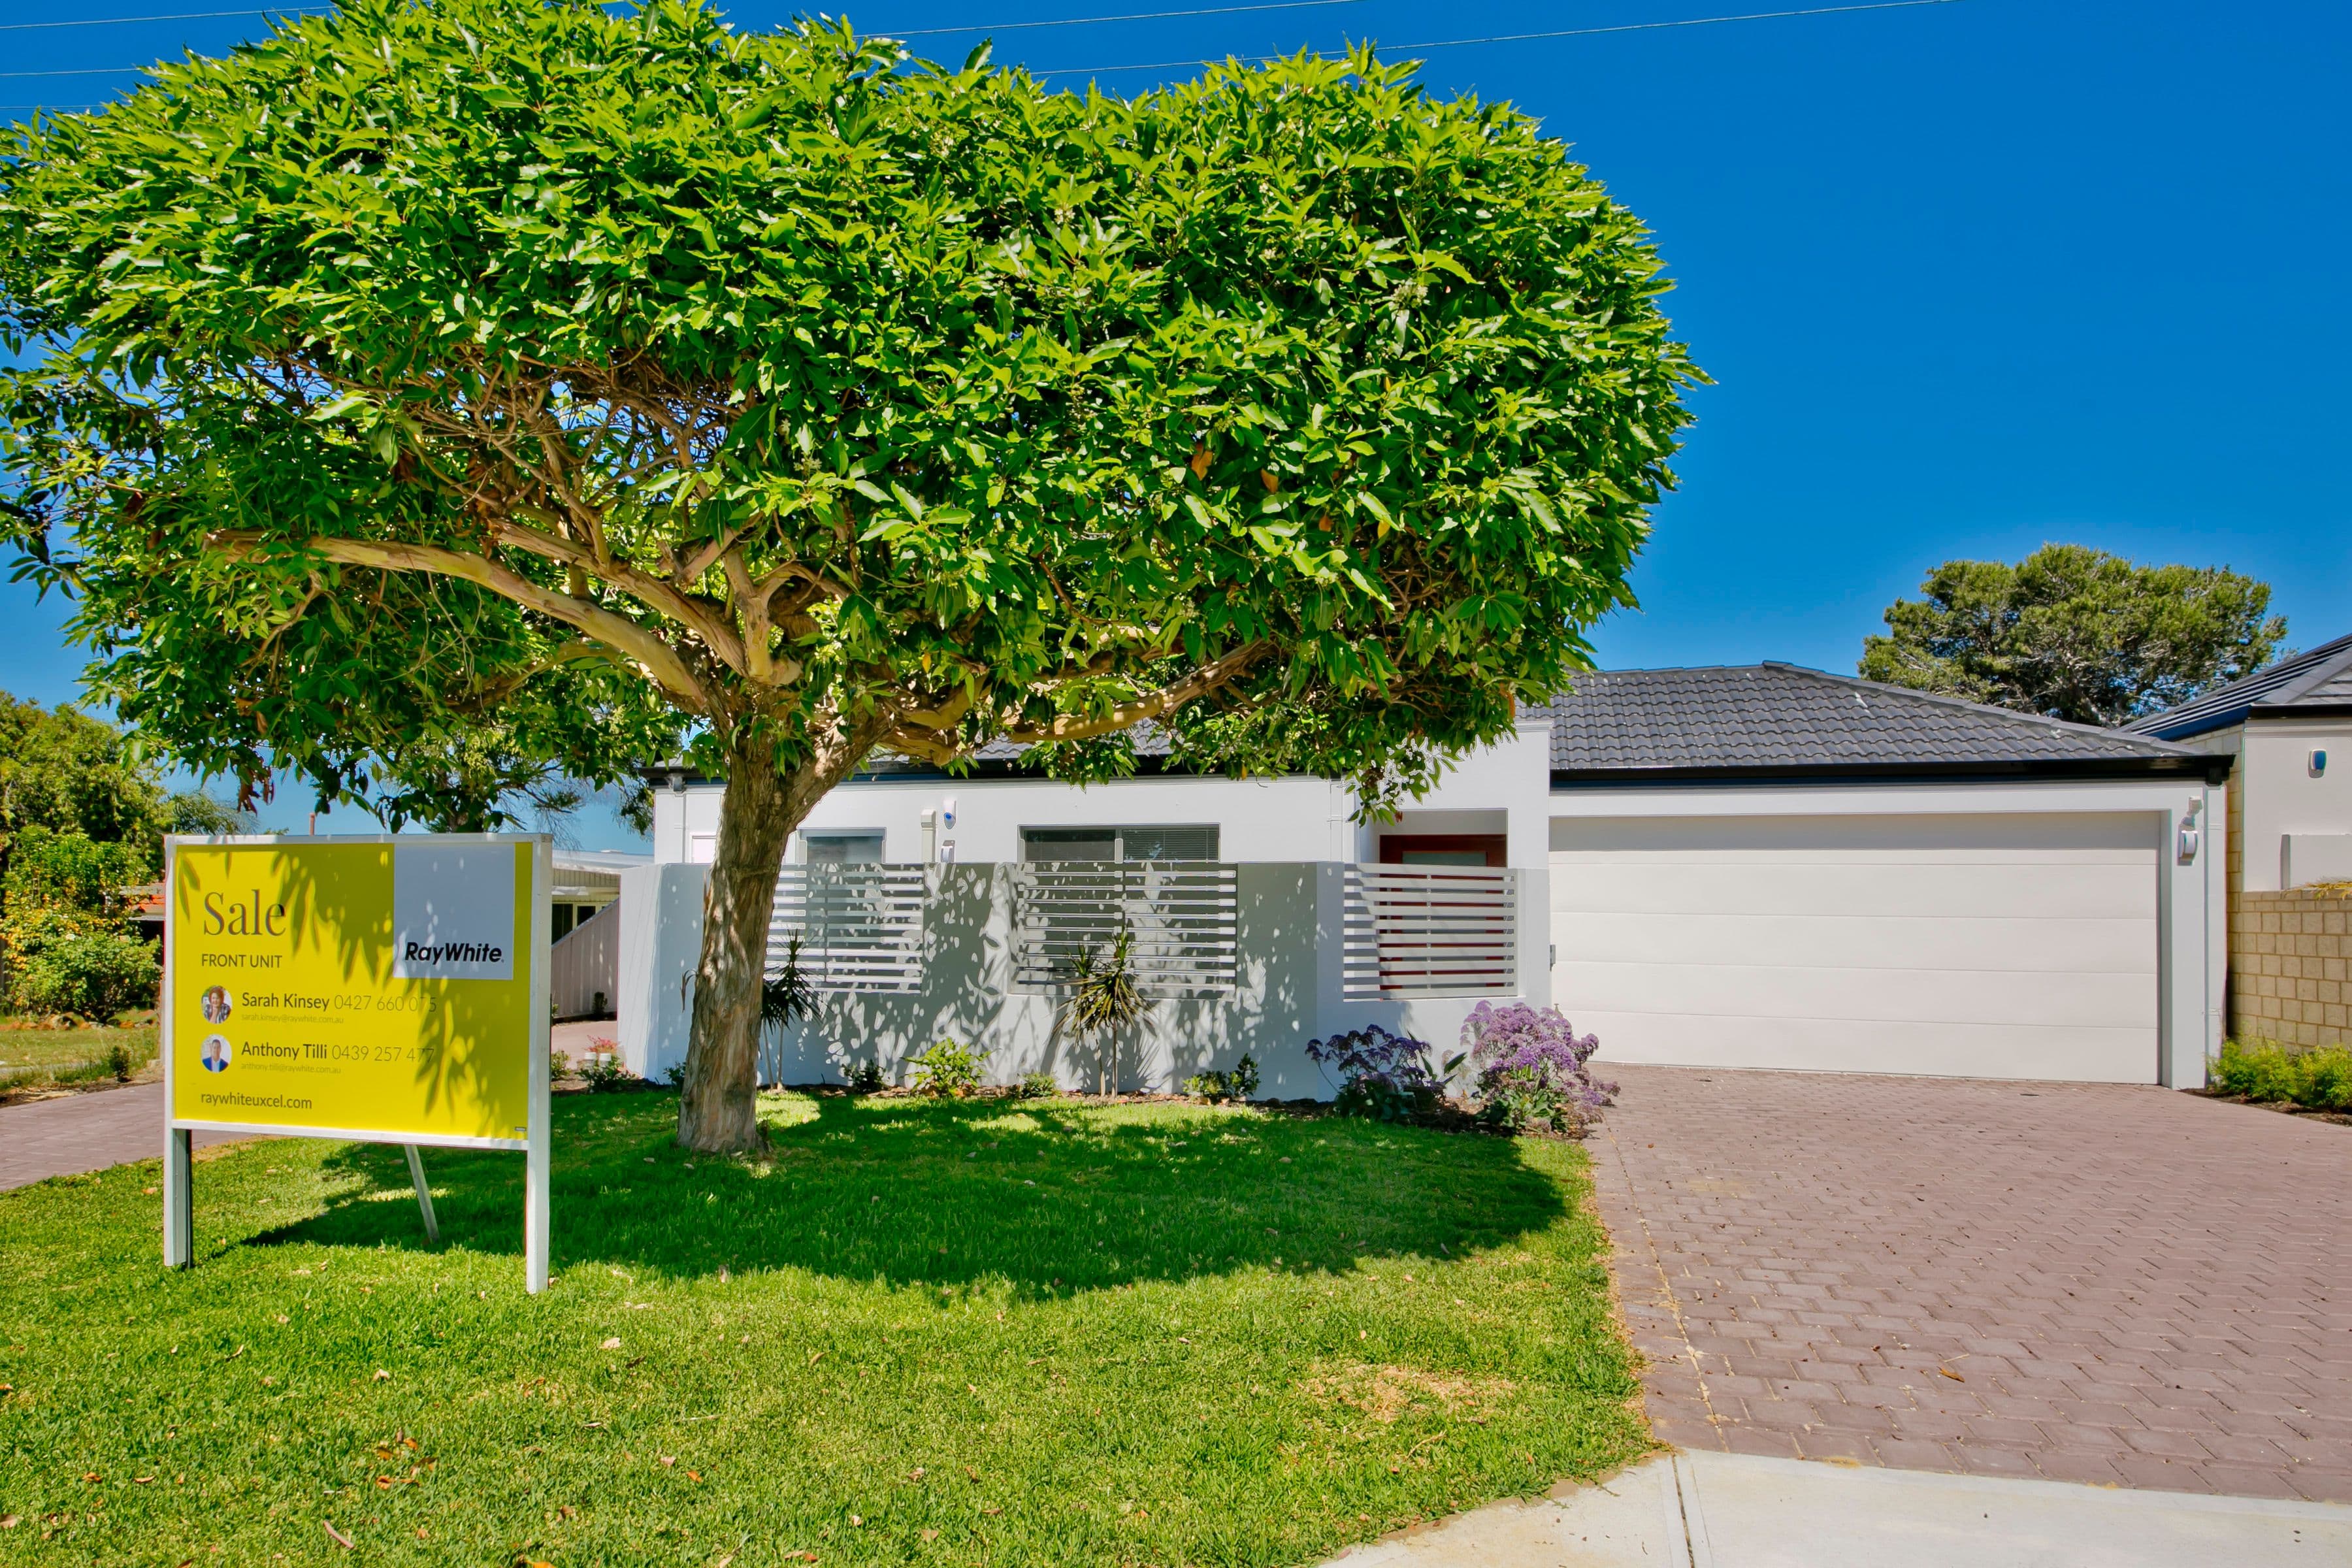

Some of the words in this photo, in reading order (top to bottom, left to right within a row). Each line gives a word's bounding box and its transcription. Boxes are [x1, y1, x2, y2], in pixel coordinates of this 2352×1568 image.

[204, 889, 286, 936] Sale
[202, 954, 246, 967] FRONT
[250, 955, 283, 968] UNIT
[242, 992, 279, 1007] Sarah
[284, 993, 329, 1012] Kinsey
[335, 994, 372, 1010] 0427
[377, 996, 404, 1011] 660
[241, 1041, 299, 1060] Anthony
[303, 1044, 327, 1059] Tilli
[332, 1045, 369, 1060] 0439
[374, 1046, 402, 1062] 257
[406, 1047, 434, 1063] 477
[201, 1092, 312, 1109] raywhiteuxcel.com
